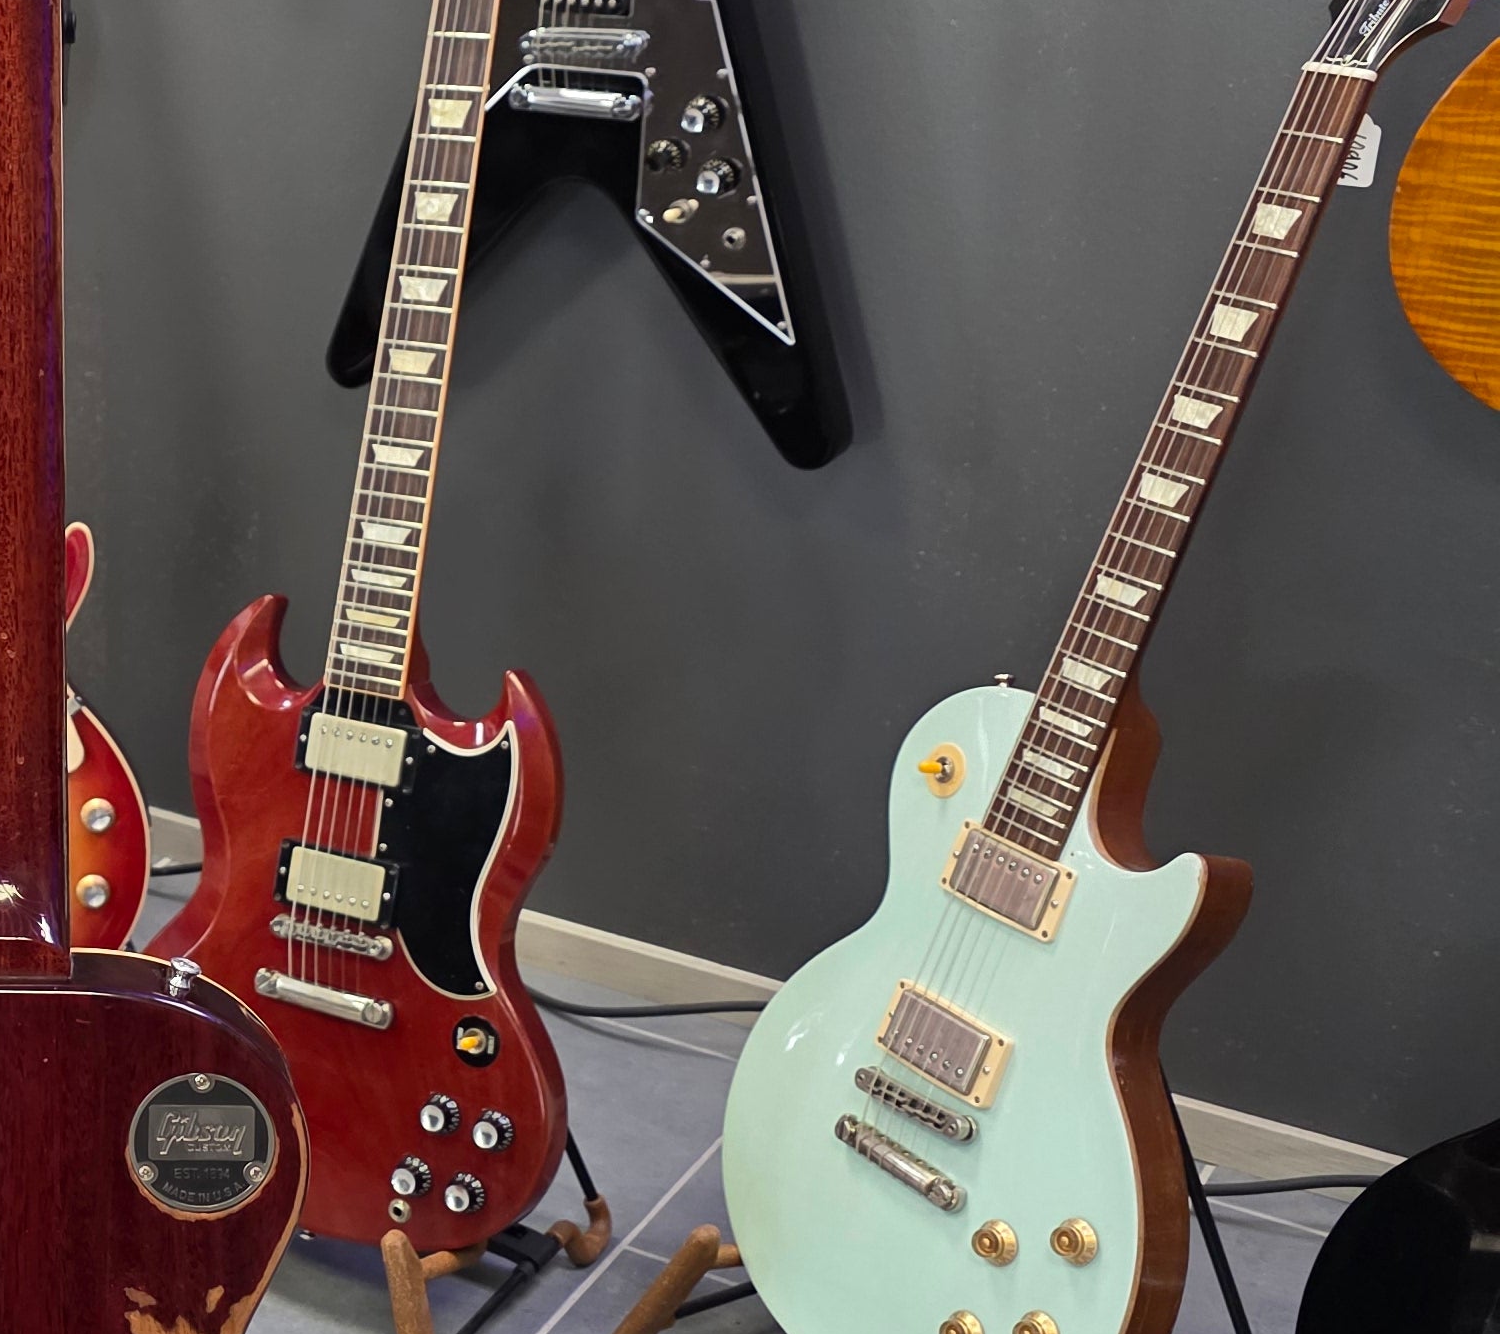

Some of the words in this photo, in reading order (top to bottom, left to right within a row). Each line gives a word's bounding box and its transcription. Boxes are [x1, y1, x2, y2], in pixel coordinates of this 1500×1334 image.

[156, 1110, 247, 1156] Gibson
[173, 1167, 201, 1179] EST.
[162, 1181, 196, 1202] MADE
[198, 1192, 210, 1204] IN
